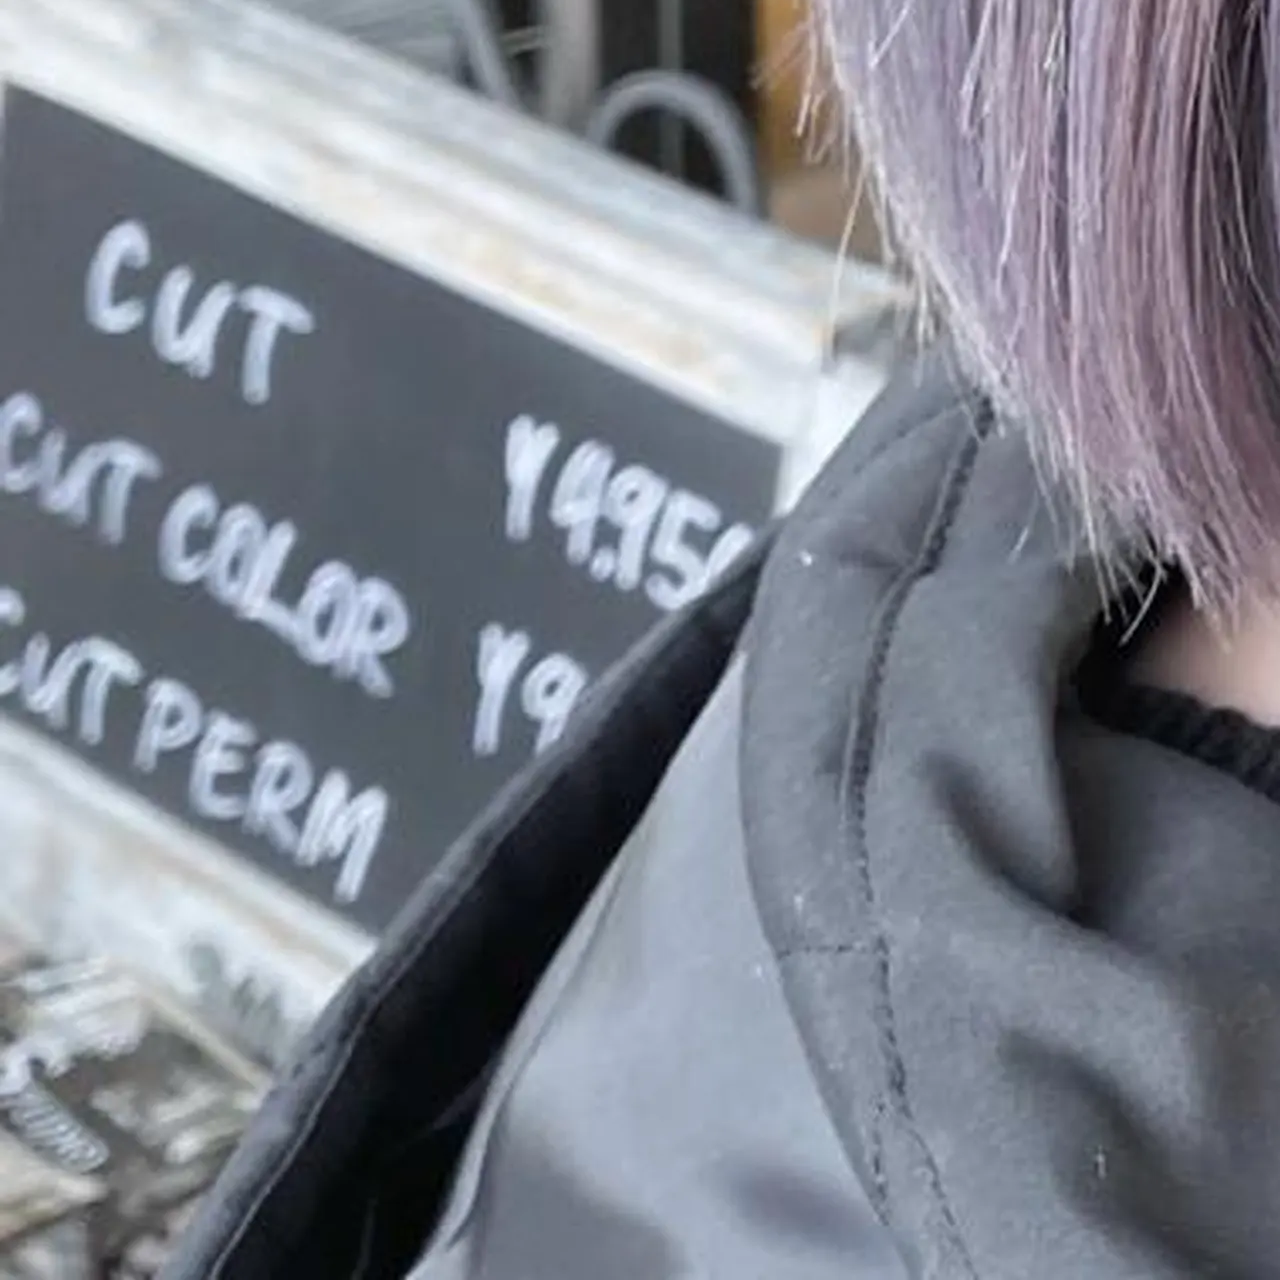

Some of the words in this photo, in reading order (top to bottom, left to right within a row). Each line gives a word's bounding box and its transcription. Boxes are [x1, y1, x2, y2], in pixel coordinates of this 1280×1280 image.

[85, 220, 313, 403] CUT
[0, 392, 162, 544] CUT
[159, 485, 408, 698] COLOR
[134, 678, 388, 902] PERM
